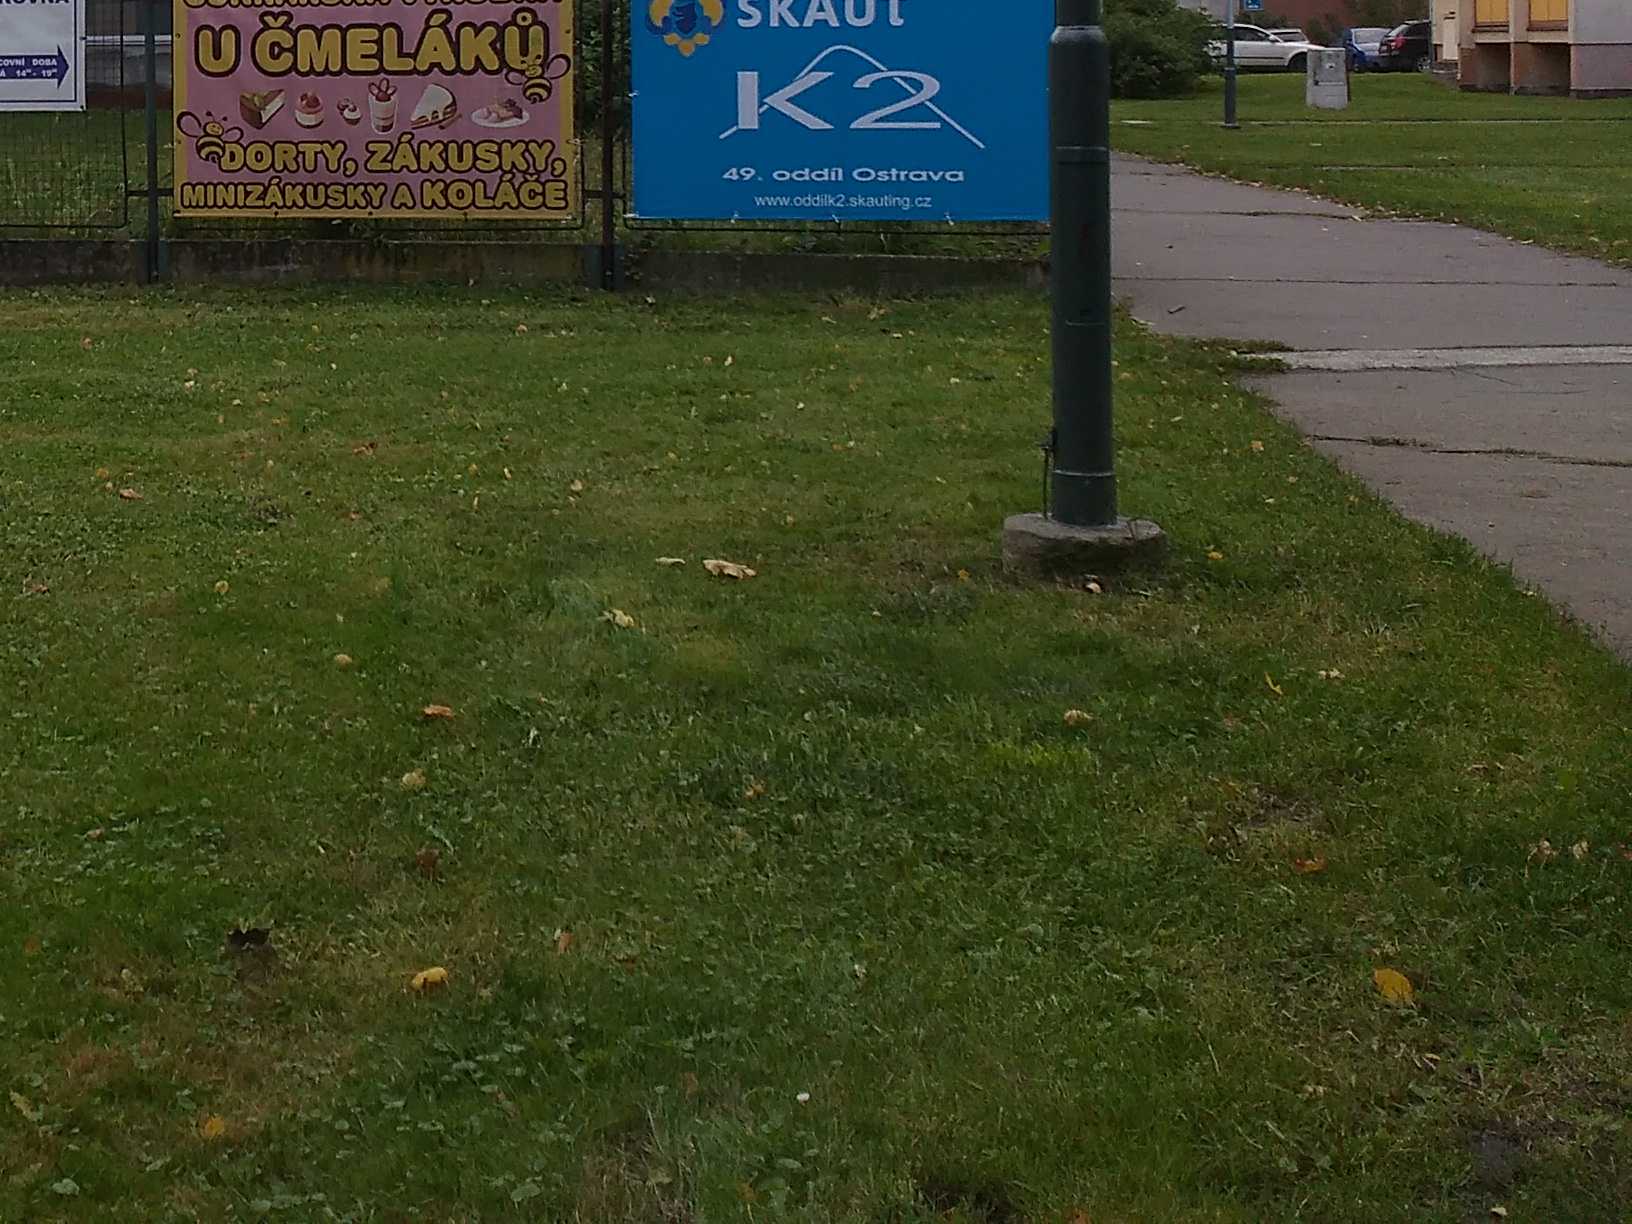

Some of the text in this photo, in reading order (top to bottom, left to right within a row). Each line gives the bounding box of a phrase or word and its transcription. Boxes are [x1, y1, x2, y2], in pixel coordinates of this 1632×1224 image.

[194, 7, 550, 77] U ČMELÁKŮ
[737, 71, 942, 130] K2
[220, 132, 568, 177] DORTY, ZÁKUSKY,
[722, 167, 764, 181] 49.
[852, 167, 965, 182] Ostrava
[181, 173, 567, 210] MINIZÁKUSKY A KOLÁČE
[754, 194, 932, 210] www.oddilk2.skauting.cz
